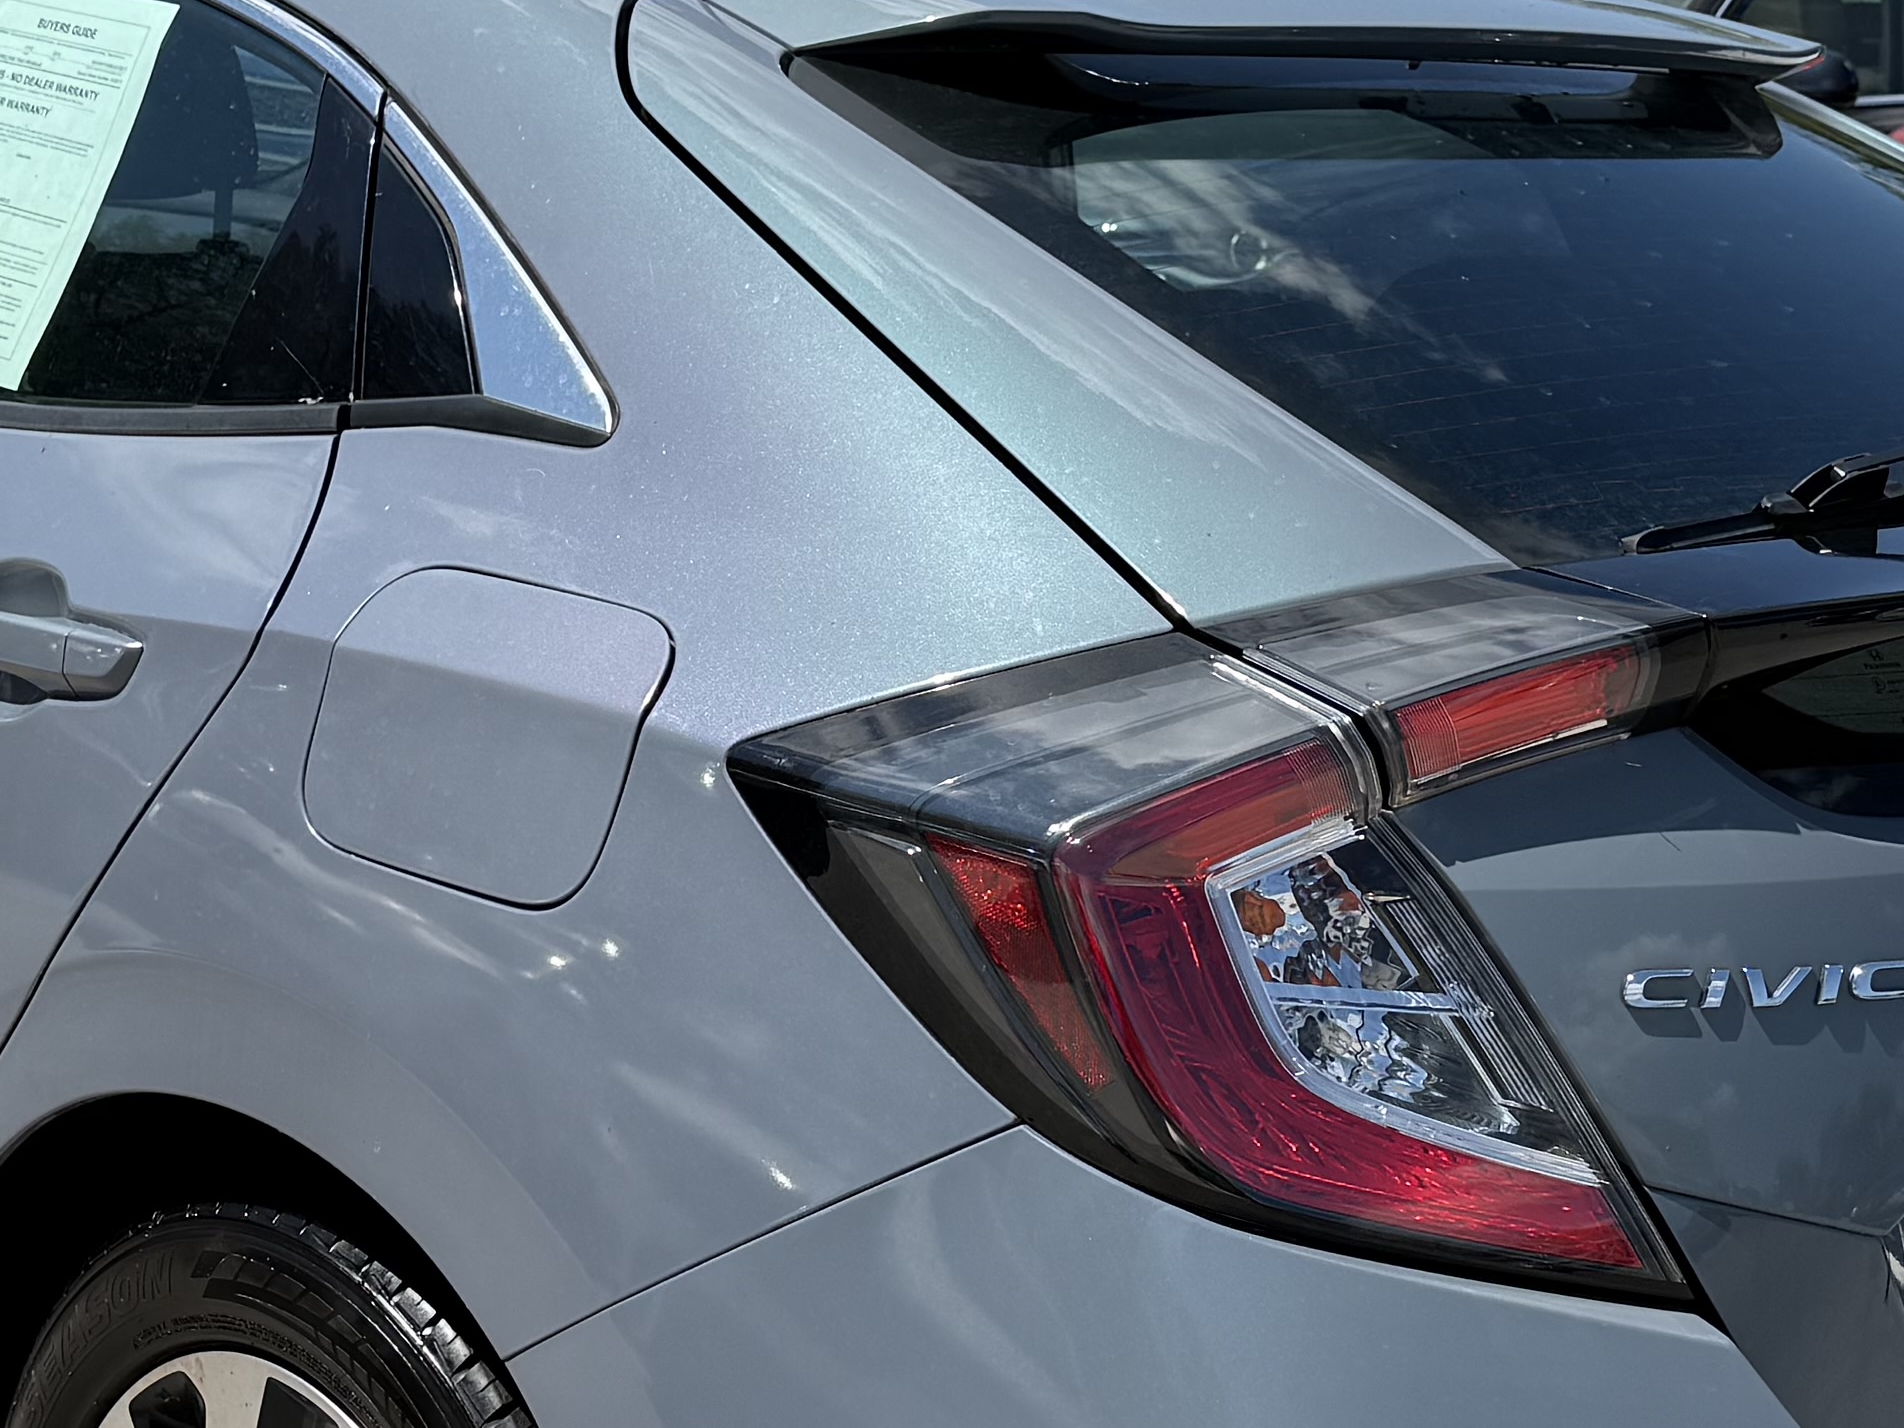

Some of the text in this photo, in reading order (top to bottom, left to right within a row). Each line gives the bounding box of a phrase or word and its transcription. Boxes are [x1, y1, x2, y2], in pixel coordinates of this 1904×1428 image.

[23, 75, 55, 91] DEALER
[55, 83, 100, 102] WARRANTY
[6, 99, 53, 117] WARRANTY
